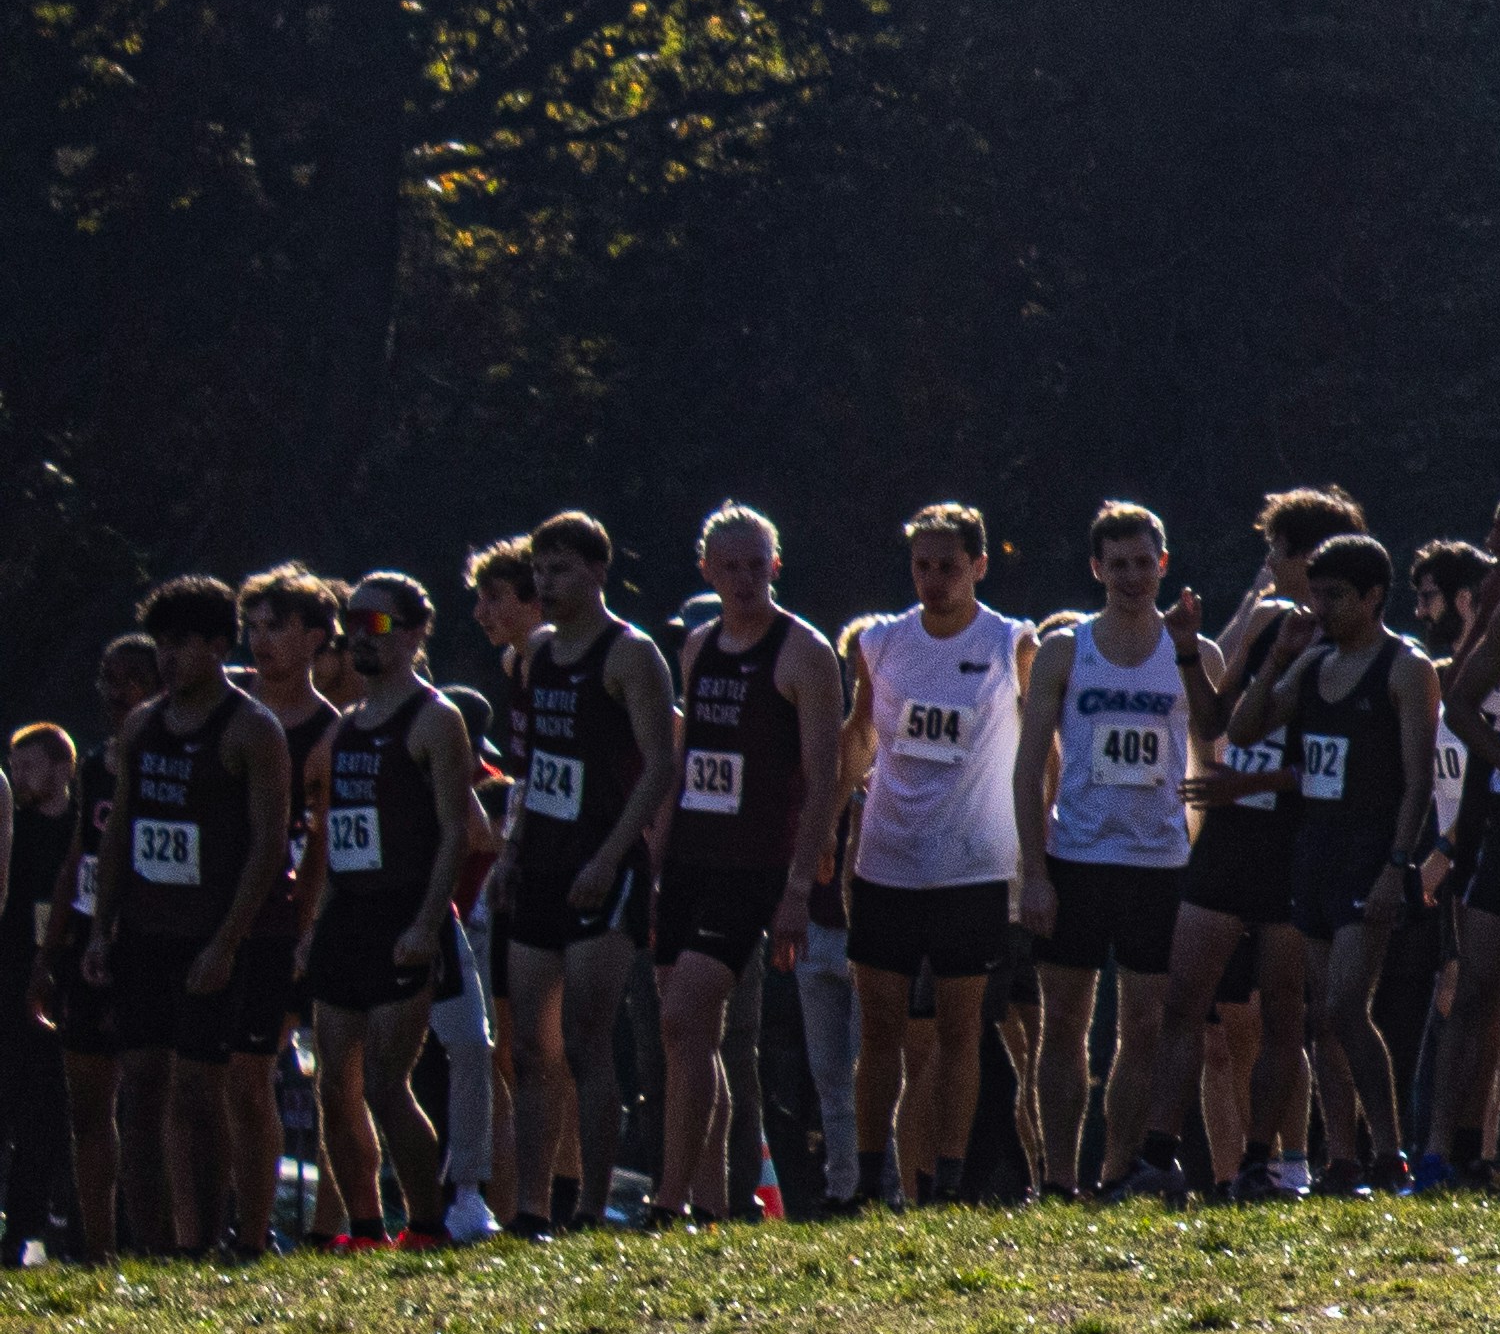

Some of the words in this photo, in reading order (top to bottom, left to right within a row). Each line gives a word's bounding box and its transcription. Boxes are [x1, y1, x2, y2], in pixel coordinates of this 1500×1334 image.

[1079, 688, 1177, 717] CASE
[907, 704, 960, 744] 504
[1104, 730, 1158, 765] 409
[534, 758, 572, 799] 324
[694, 755, 733, 794] 329
[142, 827, 188, 863] 328
